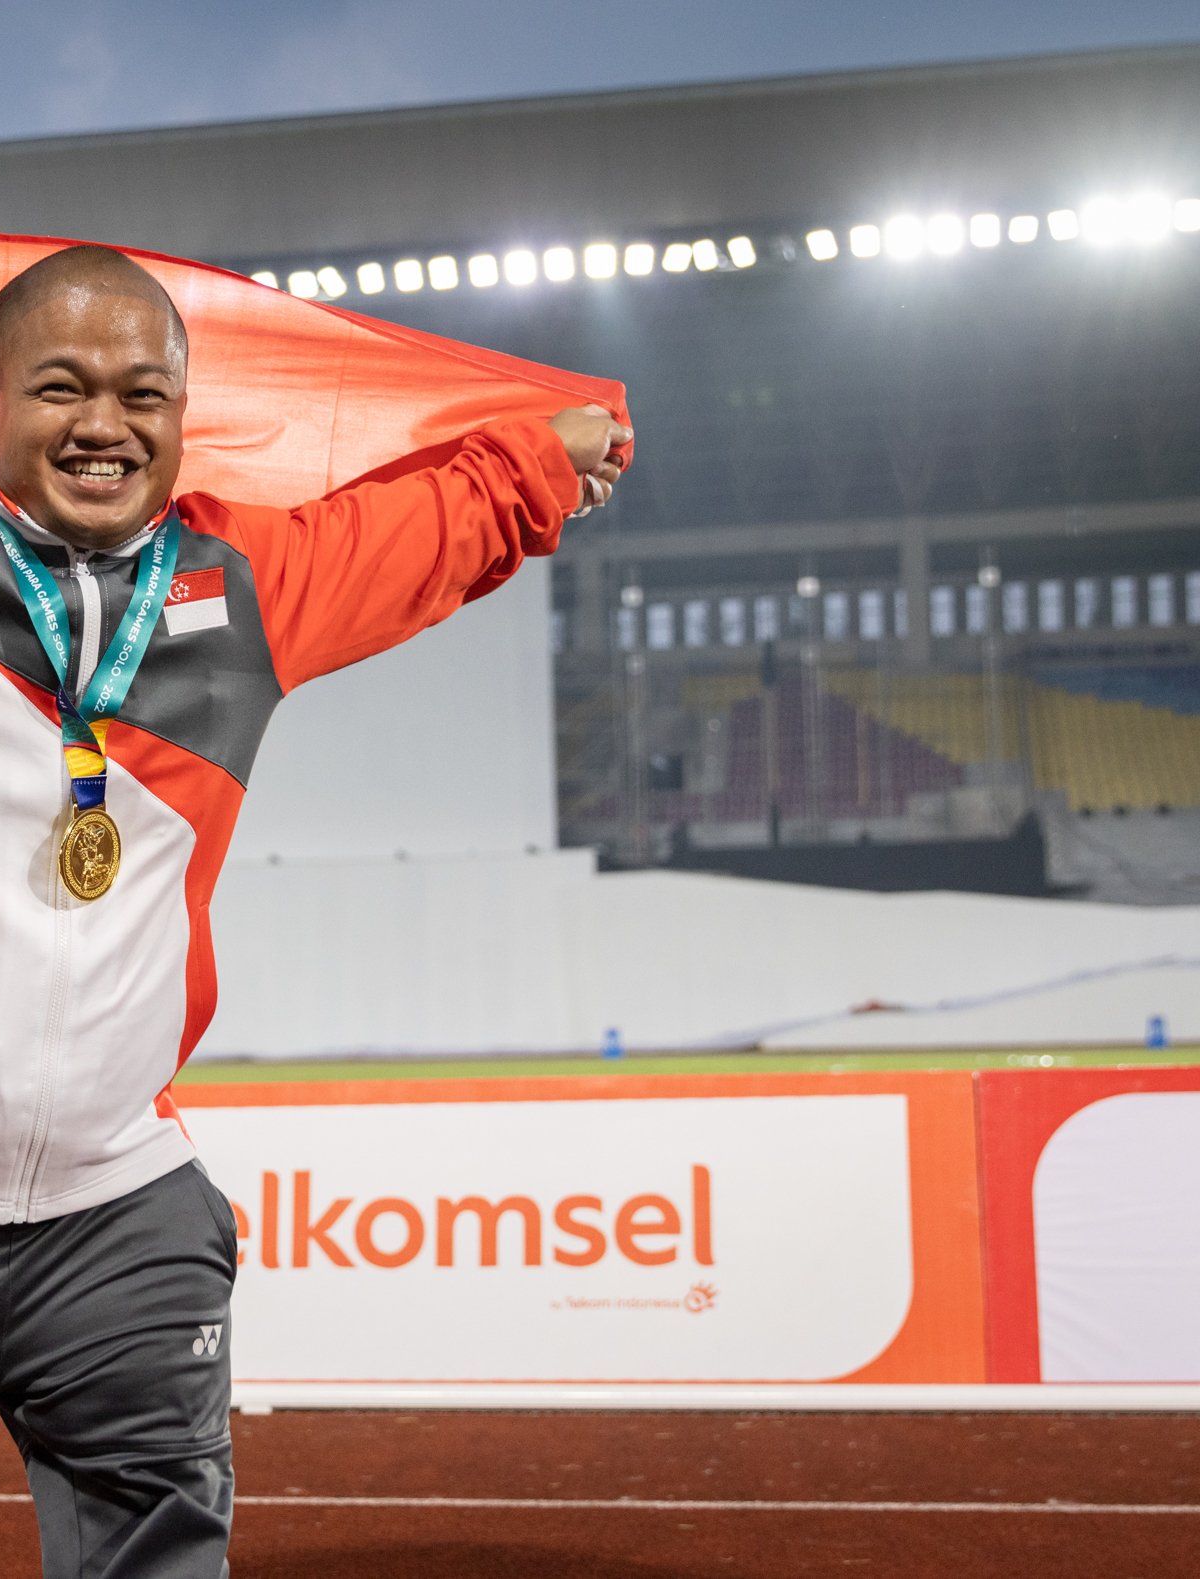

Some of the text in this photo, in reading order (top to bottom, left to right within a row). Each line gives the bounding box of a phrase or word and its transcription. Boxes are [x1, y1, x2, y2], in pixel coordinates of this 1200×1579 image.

[145, 565, 161, 597] PARA
[4, 542, 29, 571] ASEAN
[22, 569, 42, 592] PARA
[36, 590, 59, 632] GAMES
[53, 633, 68, 669] SOLO
[127, 599, 152, 643] GAMES
[111, 643, 133, 677] SOLO
[93, 684, 114, 713] 2022
[231, 1164, 714, 1270] lkomsel
